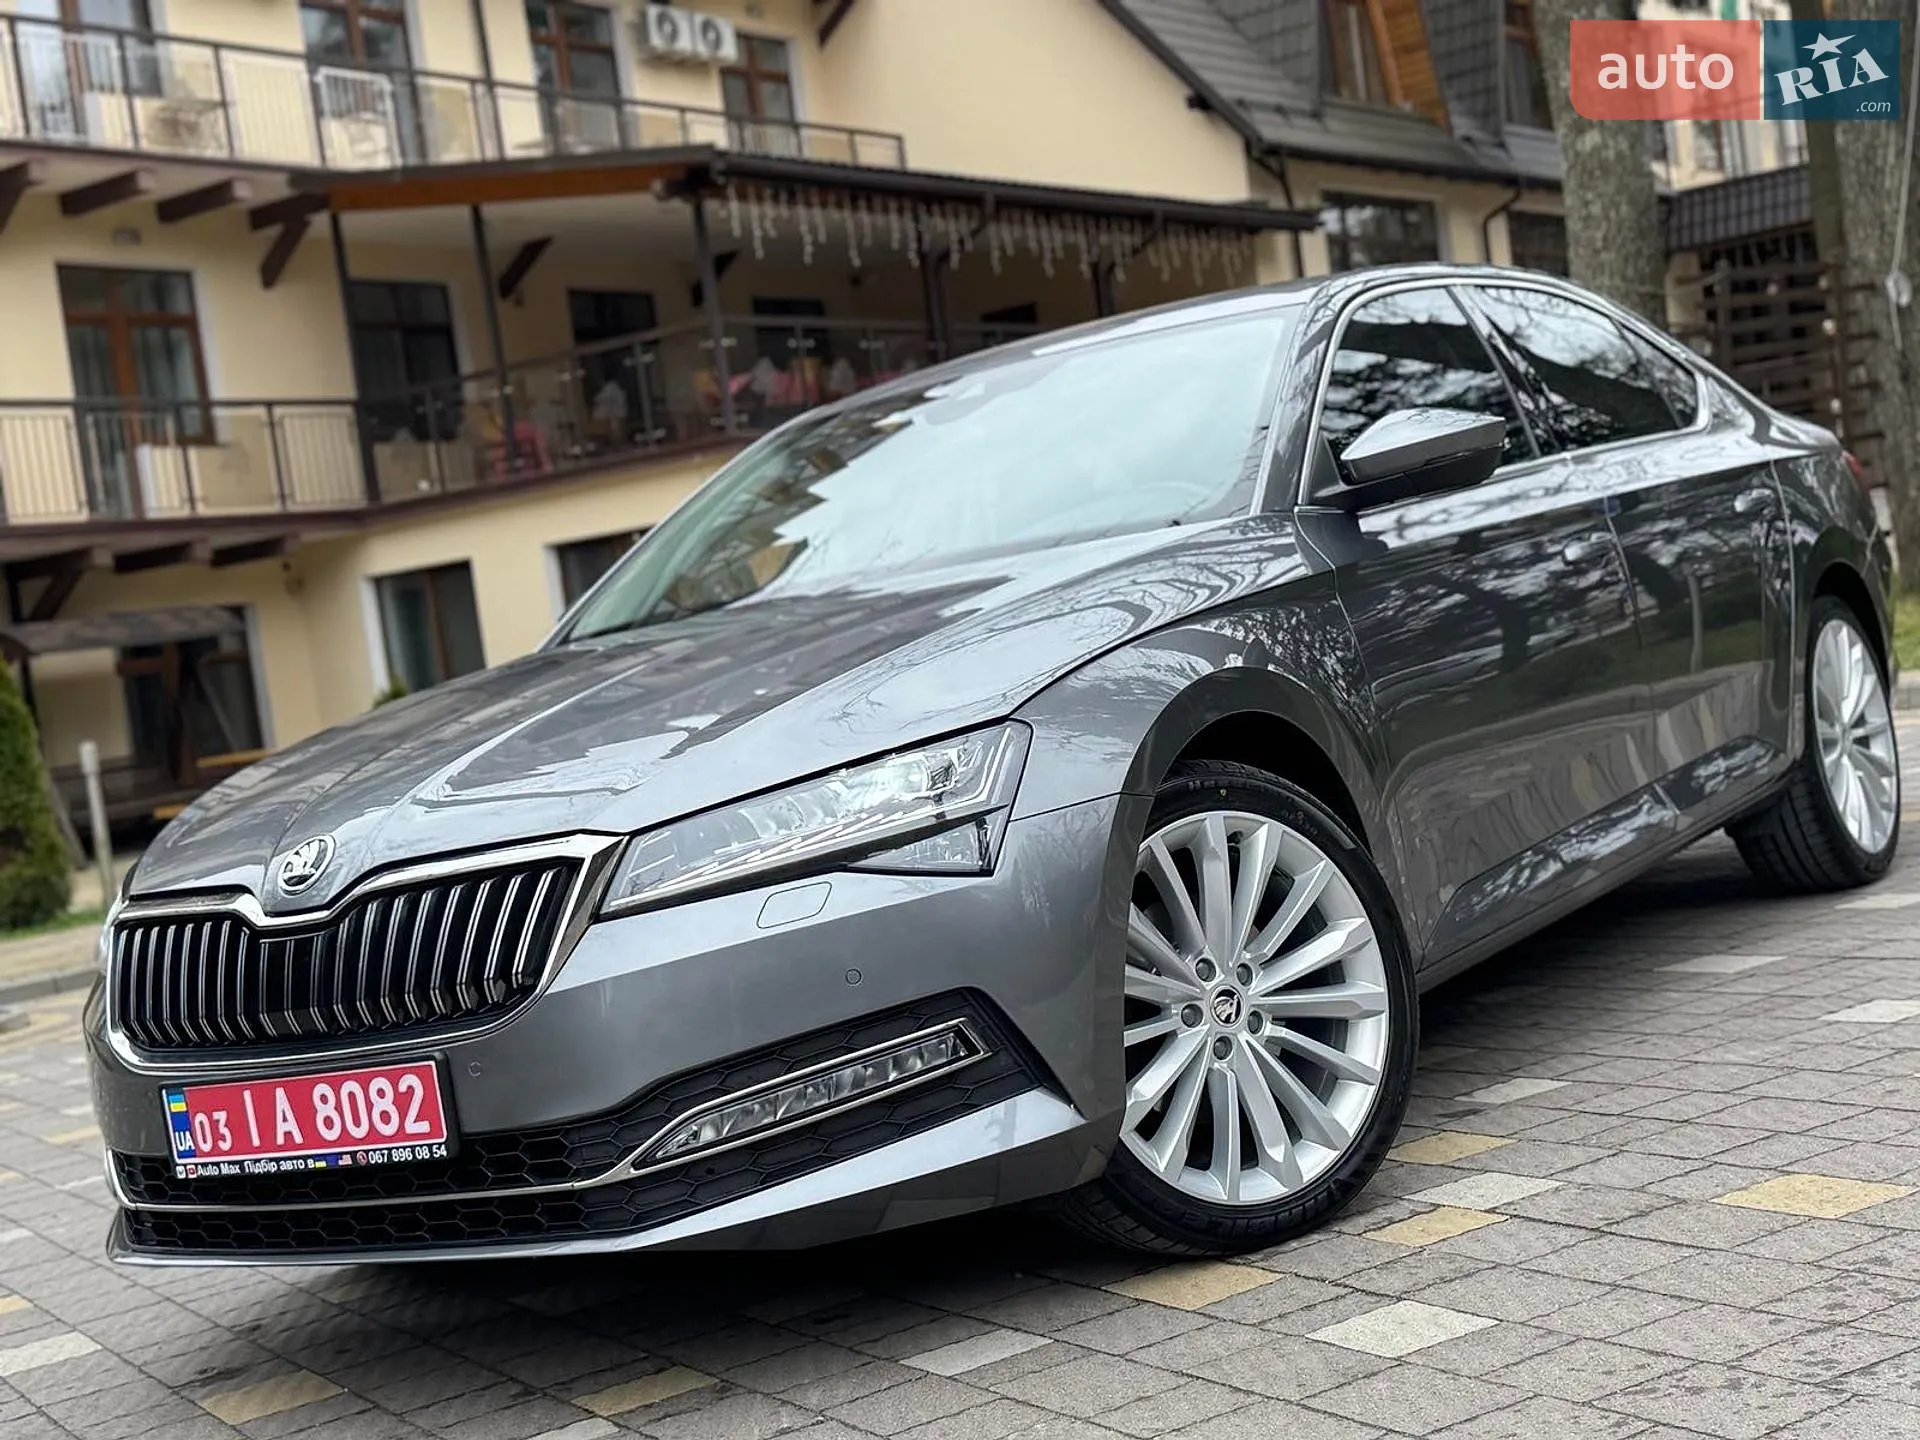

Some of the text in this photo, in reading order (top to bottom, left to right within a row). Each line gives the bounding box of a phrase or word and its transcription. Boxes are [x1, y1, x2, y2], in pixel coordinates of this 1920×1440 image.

[194, 1110, 232, 1152] 03
[312, 1074, 431, 1142] 8082
[175, 1131, 196, 1152] UA
[197, 1164, 219, 1177] Auto
[220, 1162, 241, 1175] Max
[279, 1159, 305, 1171] авто
[368, 1149, 388, 1164] 067
[391, 1147, 413, 1162] 896
[415, 1145, 430, 1160] 08
[432, 1144, 447, 1158] 54
